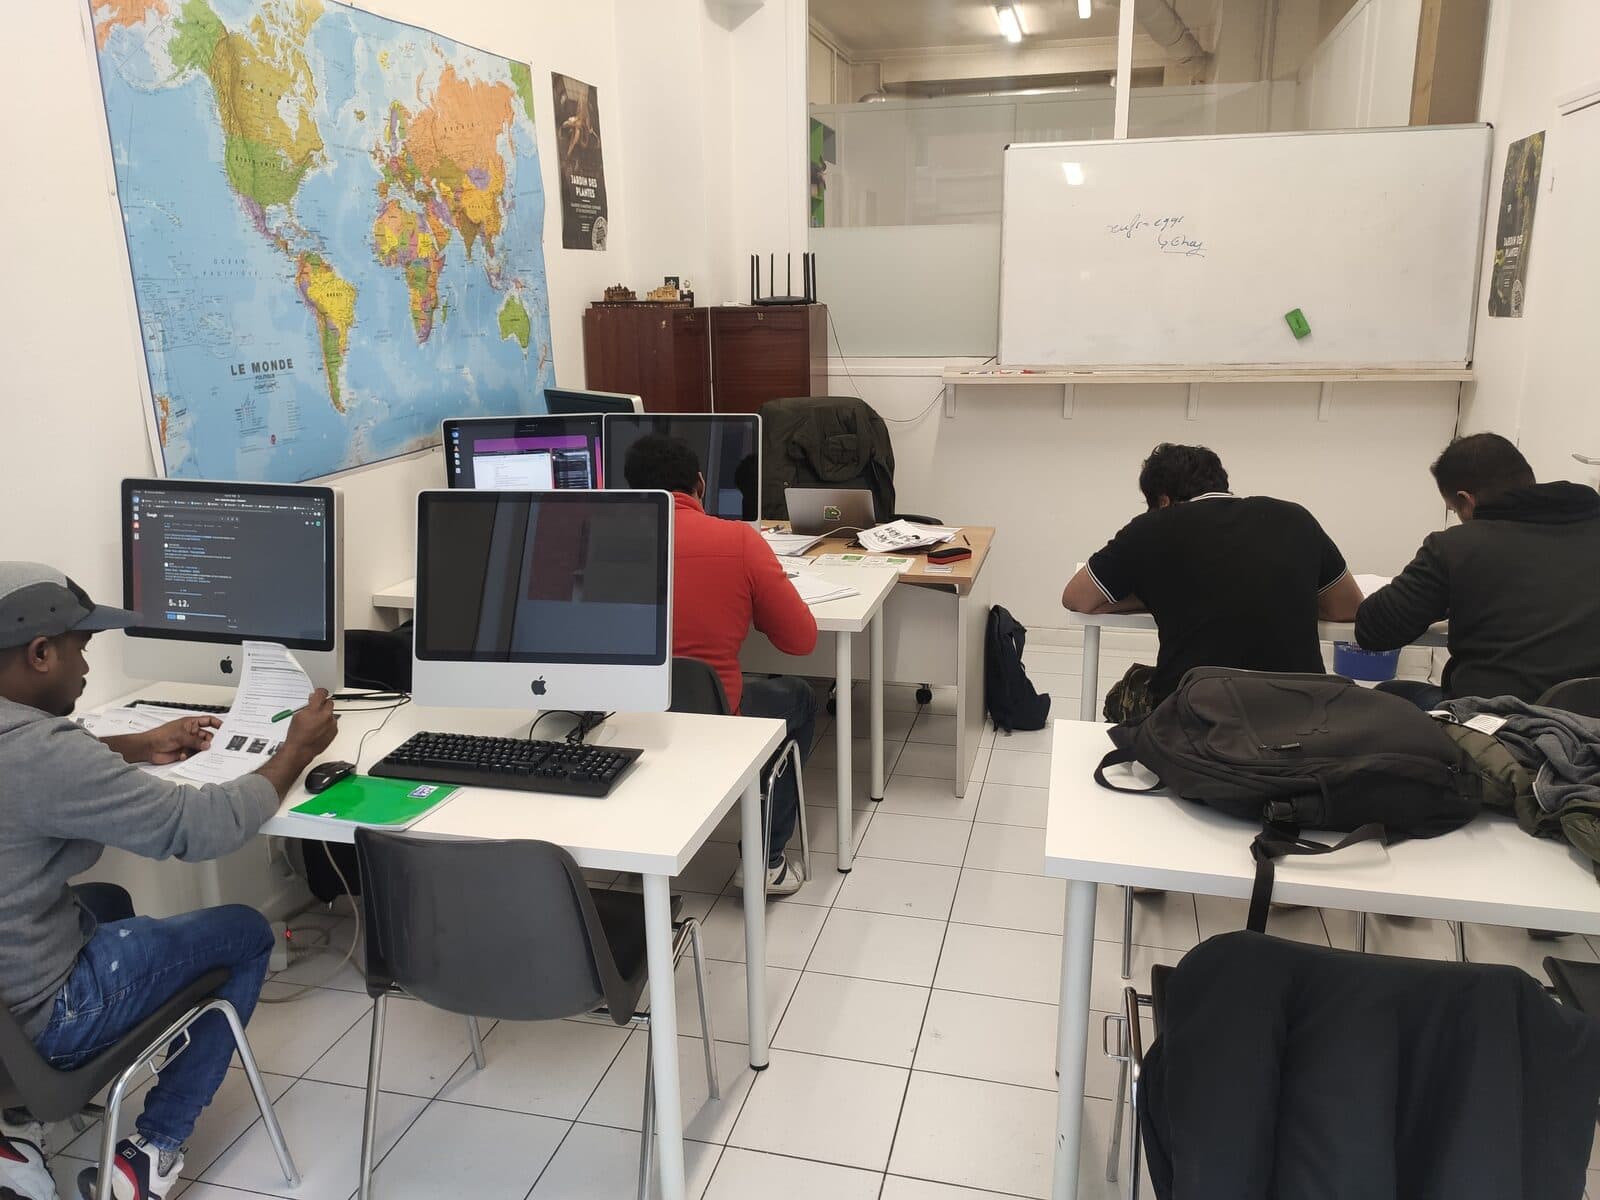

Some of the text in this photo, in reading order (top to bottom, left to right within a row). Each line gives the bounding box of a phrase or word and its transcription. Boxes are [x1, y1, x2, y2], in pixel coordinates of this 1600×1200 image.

[570, 175, 598, 188] JARDIN DES
[575, 187, 596, 198] PLANTES
[230, 358, 294, 376] LE MONDE
